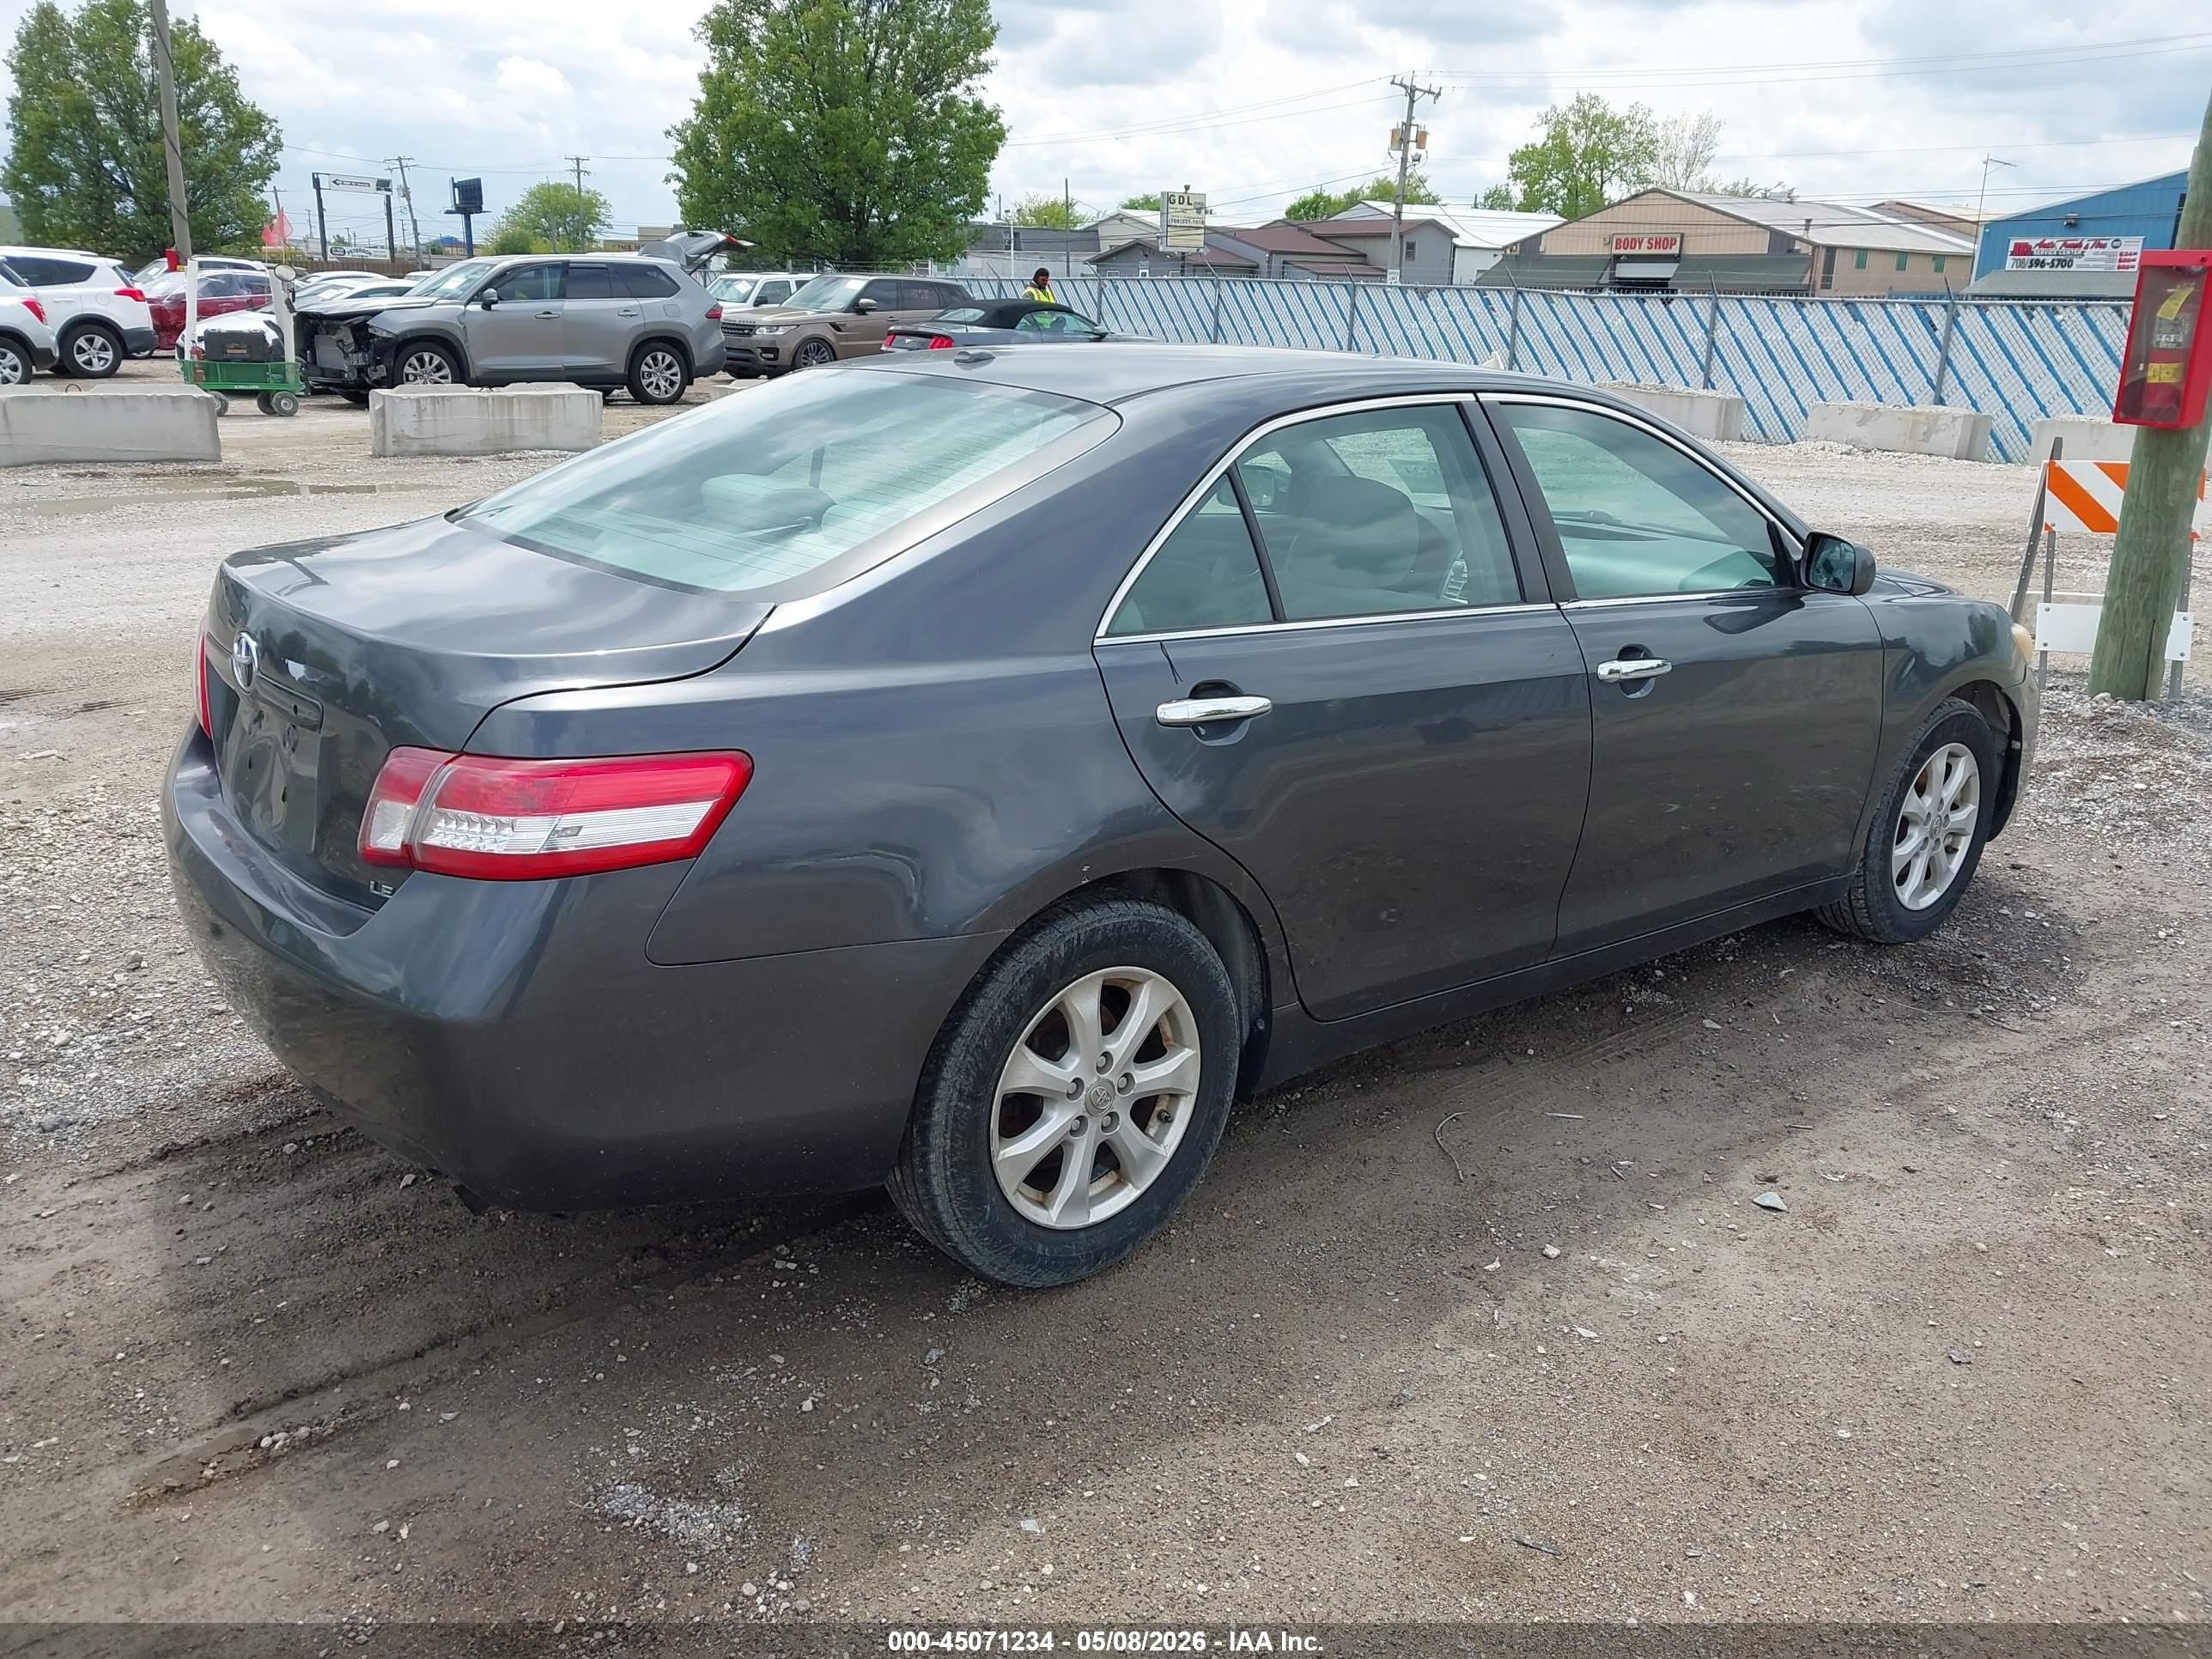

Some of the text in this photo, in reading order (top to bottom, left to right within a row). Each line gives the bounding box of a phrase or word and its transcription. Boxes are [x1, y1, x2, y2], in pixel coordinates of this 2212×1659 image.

[1169, 194, 1193, 205] GDL
[1614, 237, 1677, 250] BODY SHOP
[370, 880, 393, 898] LE
